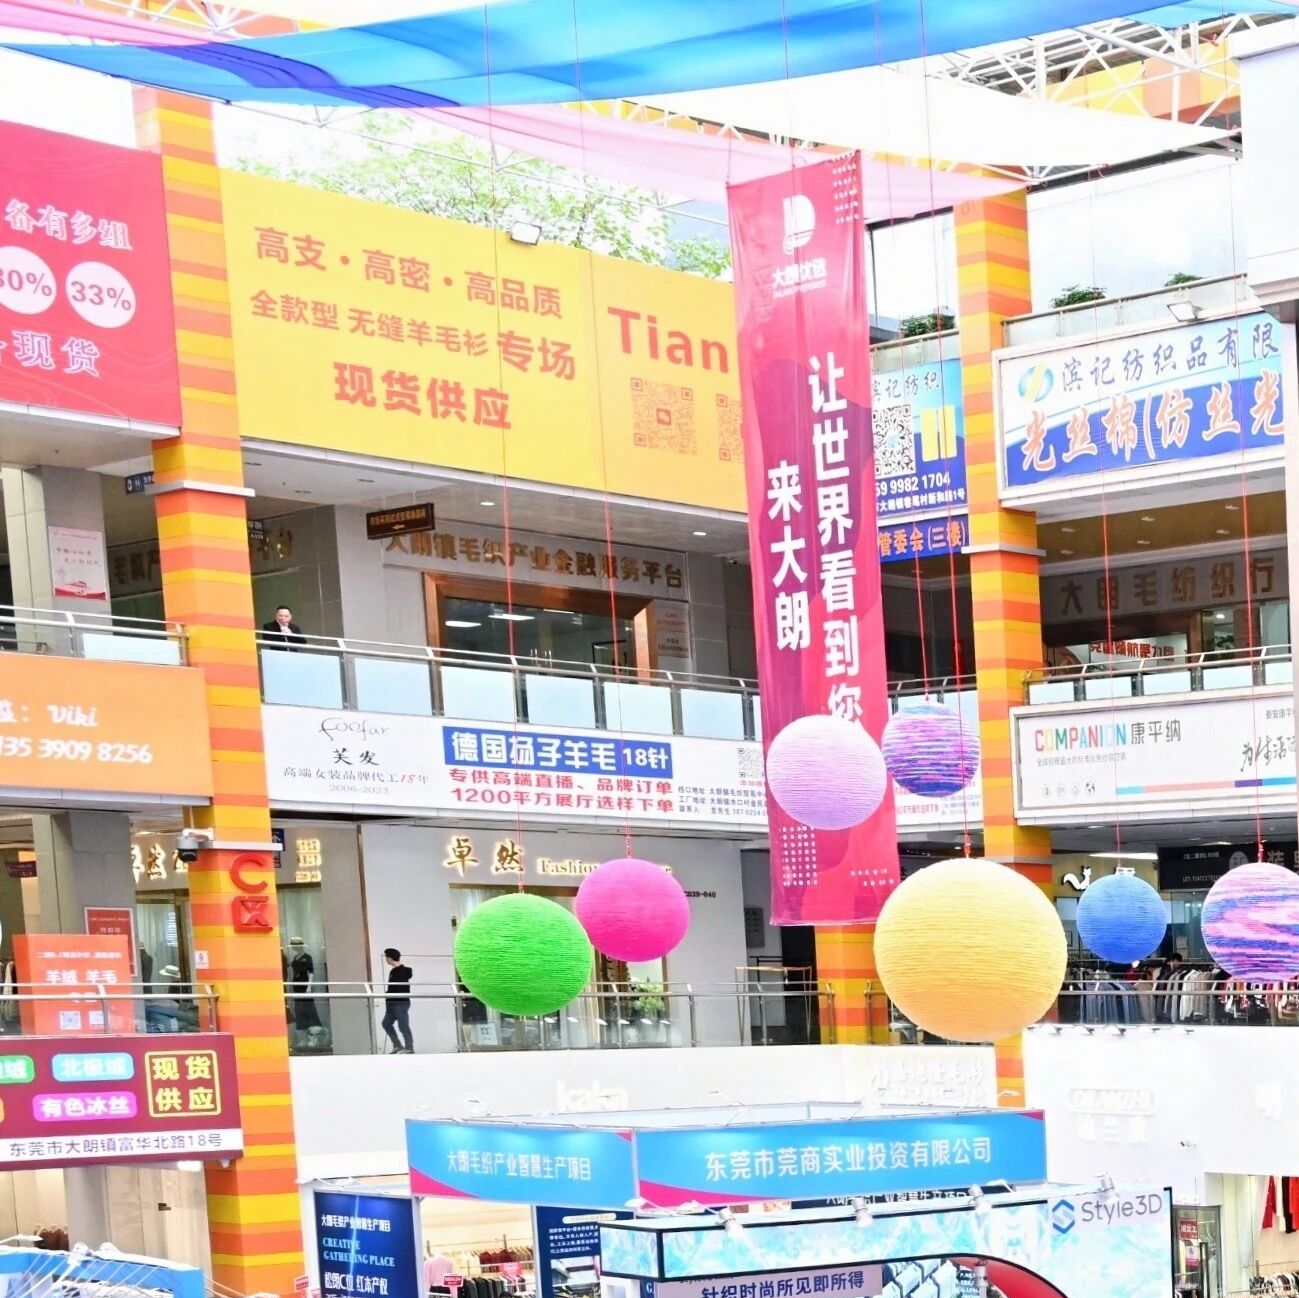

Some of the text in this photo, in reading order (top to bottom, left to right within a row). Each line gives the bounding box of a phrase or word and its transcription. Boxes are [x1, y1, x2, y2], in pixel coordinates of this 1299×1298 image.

[70, 280, 133, 312] 33%
[249, 289, 576, 382] 全款型 无缝羊毛衫 专场
[607, 307, 730, 374] Tian
[0, 330, 101, 379] 现货
[334, 361, 512, 430] 现货供应
[890, 471, 951, 495] 9982 1704
[767, 460, 811, 653] 来大朗
[1130, 718, 1181, 746] 康平纳
[38, 738, 93, 762] 3909
[96, 743, 153, 766] 8256
[623, 746, 669, 770] 18针
[152, 1055, 213, 1082] 现货
[41, 1095, 131, 1118] 有色冰丝
[154, 1086, 216, 1113] 供应
[705, 1136, 992, 1182] 东莞市莞商实业投资有限公司
[1081, 1193, 1163, 1226] Style3D
